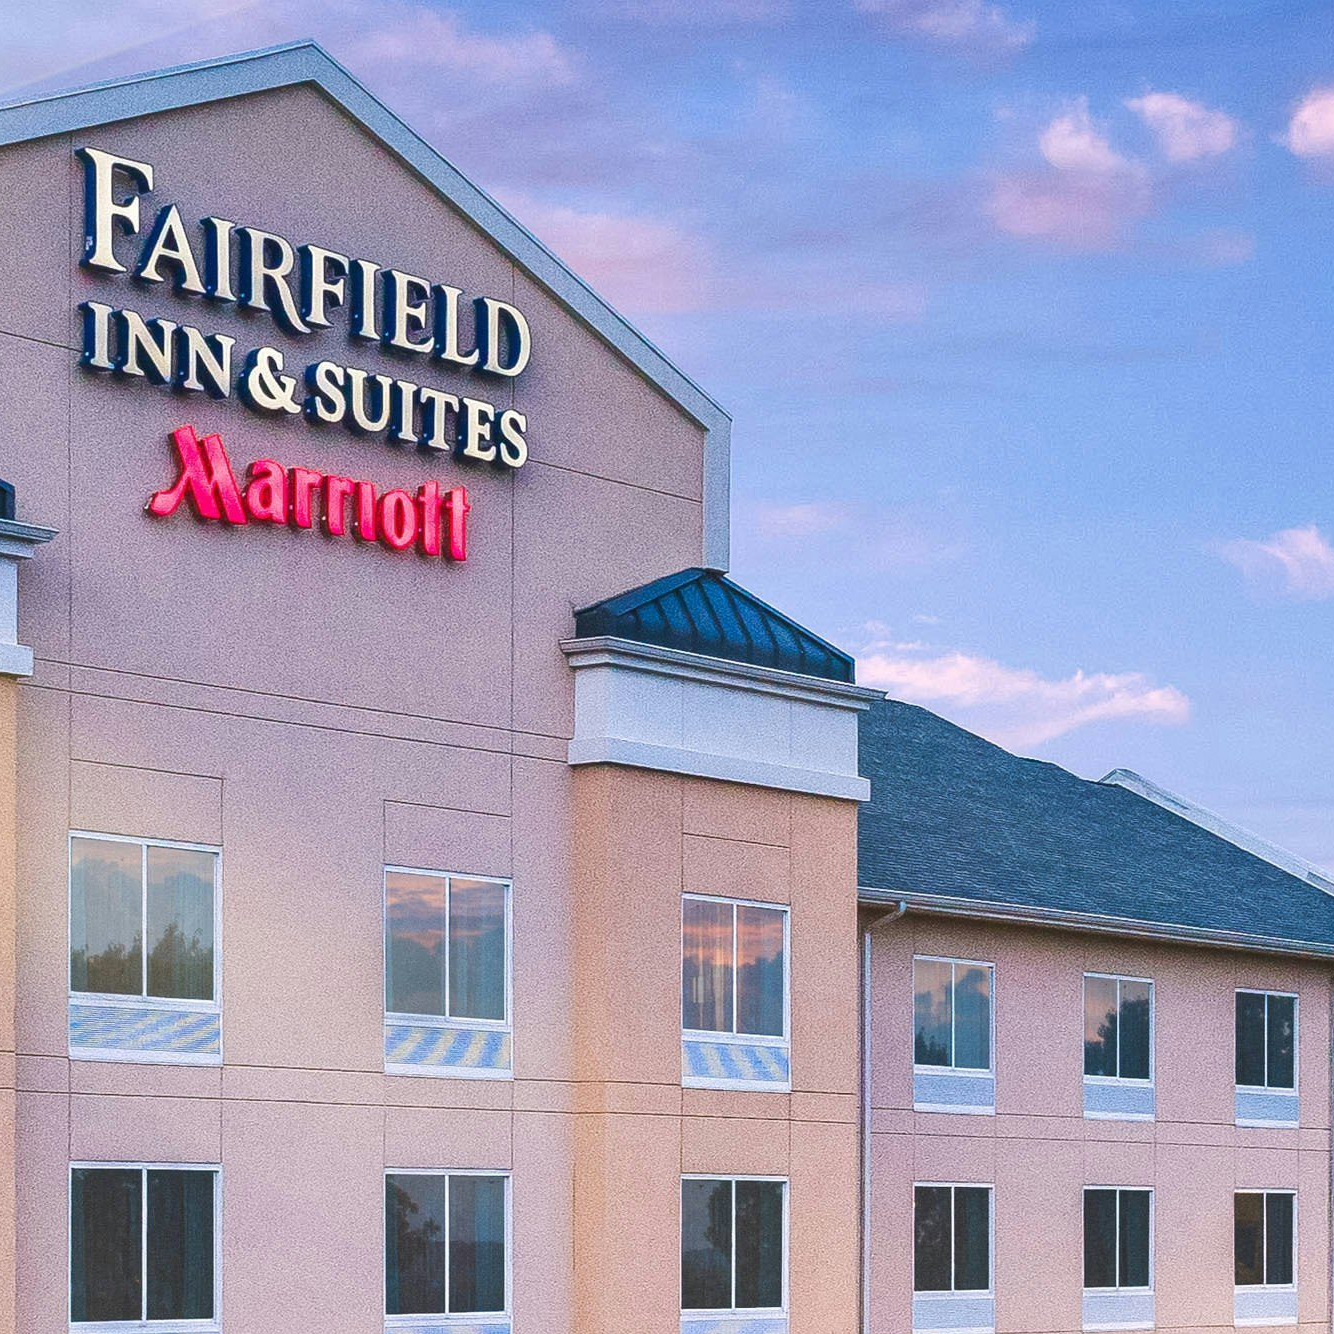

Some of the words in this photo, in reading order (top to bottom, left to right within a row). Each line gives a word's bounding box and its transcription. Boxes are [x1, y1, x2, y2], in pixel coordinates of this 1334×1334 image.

[76, 146, 532, 378] FAIRFIELD
[80, 300, 237, 399] INN
[241, 346, 302, 414] &
[310, 360, 529, 468] SUITES
[147, 424, 470, 561] Marriott
